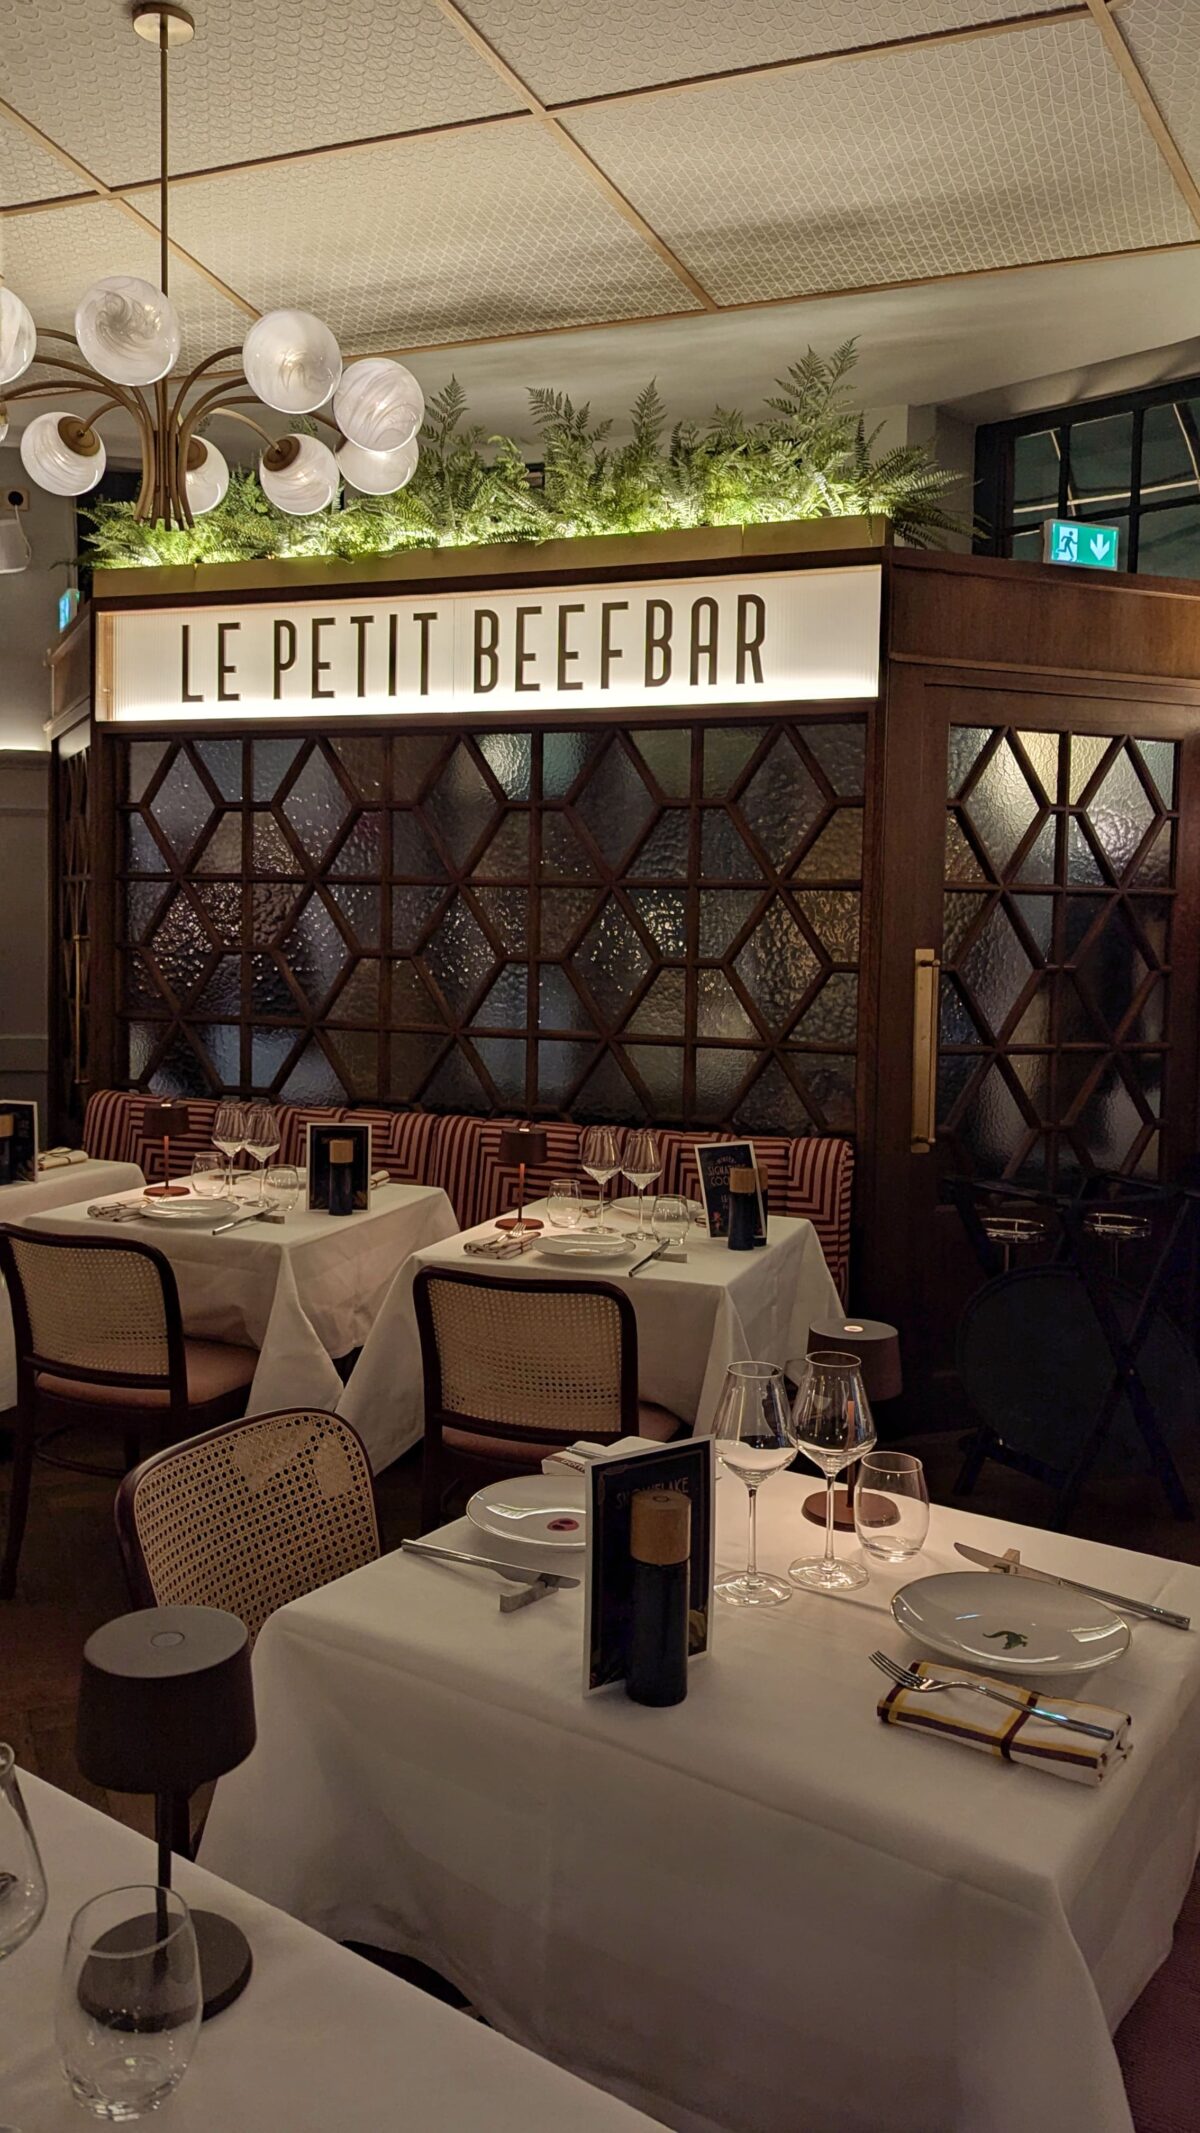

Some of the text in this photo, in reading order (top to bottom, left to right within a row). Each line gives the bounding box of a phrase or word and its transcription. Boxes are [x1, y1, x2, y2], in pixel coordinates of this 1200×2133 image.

[182, 594, 767, 703] LE PETIT BEEFBAR
[616, 1476, 689, 1510] SNAKE
